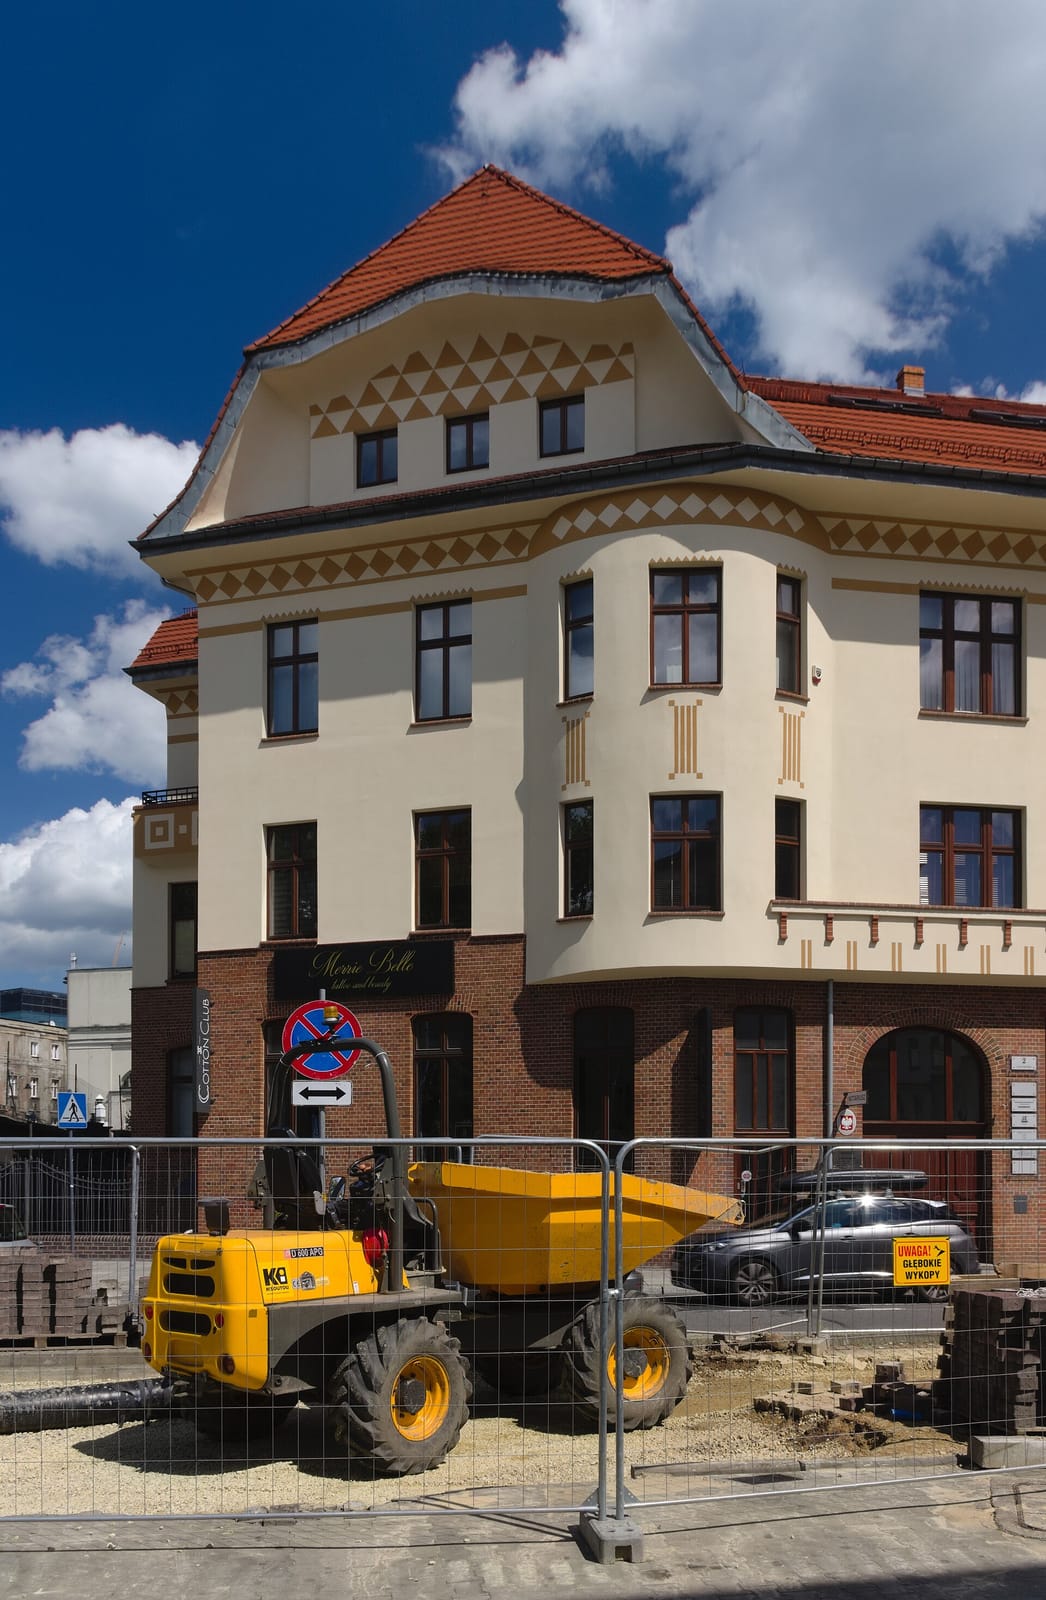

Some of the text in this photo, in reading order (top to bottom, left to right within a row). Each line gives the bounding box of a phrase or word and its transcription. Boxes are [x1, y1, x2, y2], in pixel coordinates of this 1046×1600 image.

[309, 948, 417, 976] Merrie Belle
[898, 1246, 931, 1257] UWAGA!
[903, 1259, 941, 1269] GŁĘBOKIE
[905, 1271, 940, 1280] WYKOPY
